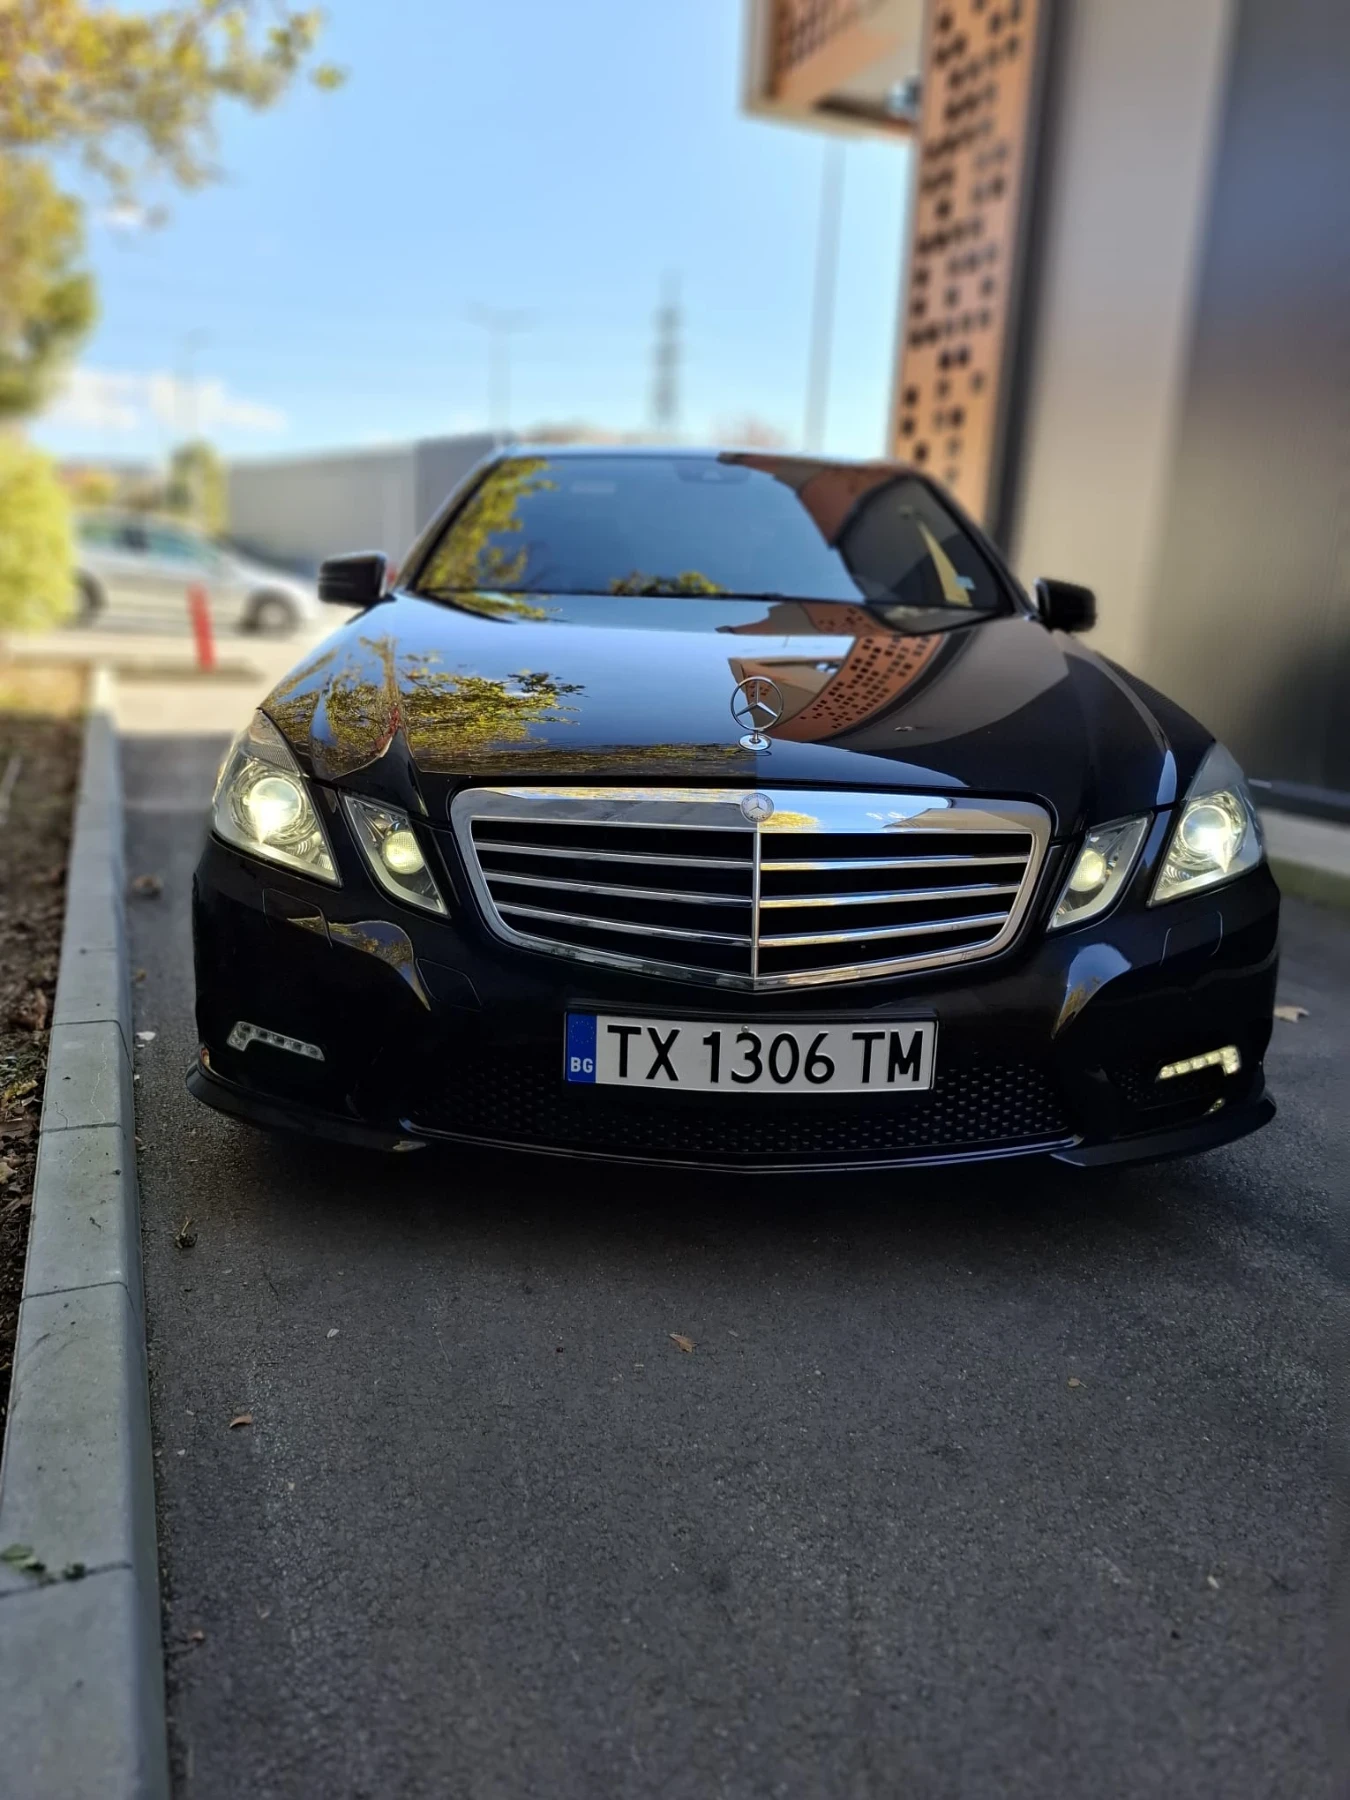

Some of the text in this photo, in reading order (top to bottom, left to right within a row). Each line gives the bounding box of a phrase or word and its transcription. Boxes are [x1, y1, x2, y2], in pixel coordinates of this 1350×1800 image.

[570, 1057, 594, 1073] BG
[607, 1025, 924, 1084] TX 1306 TM
